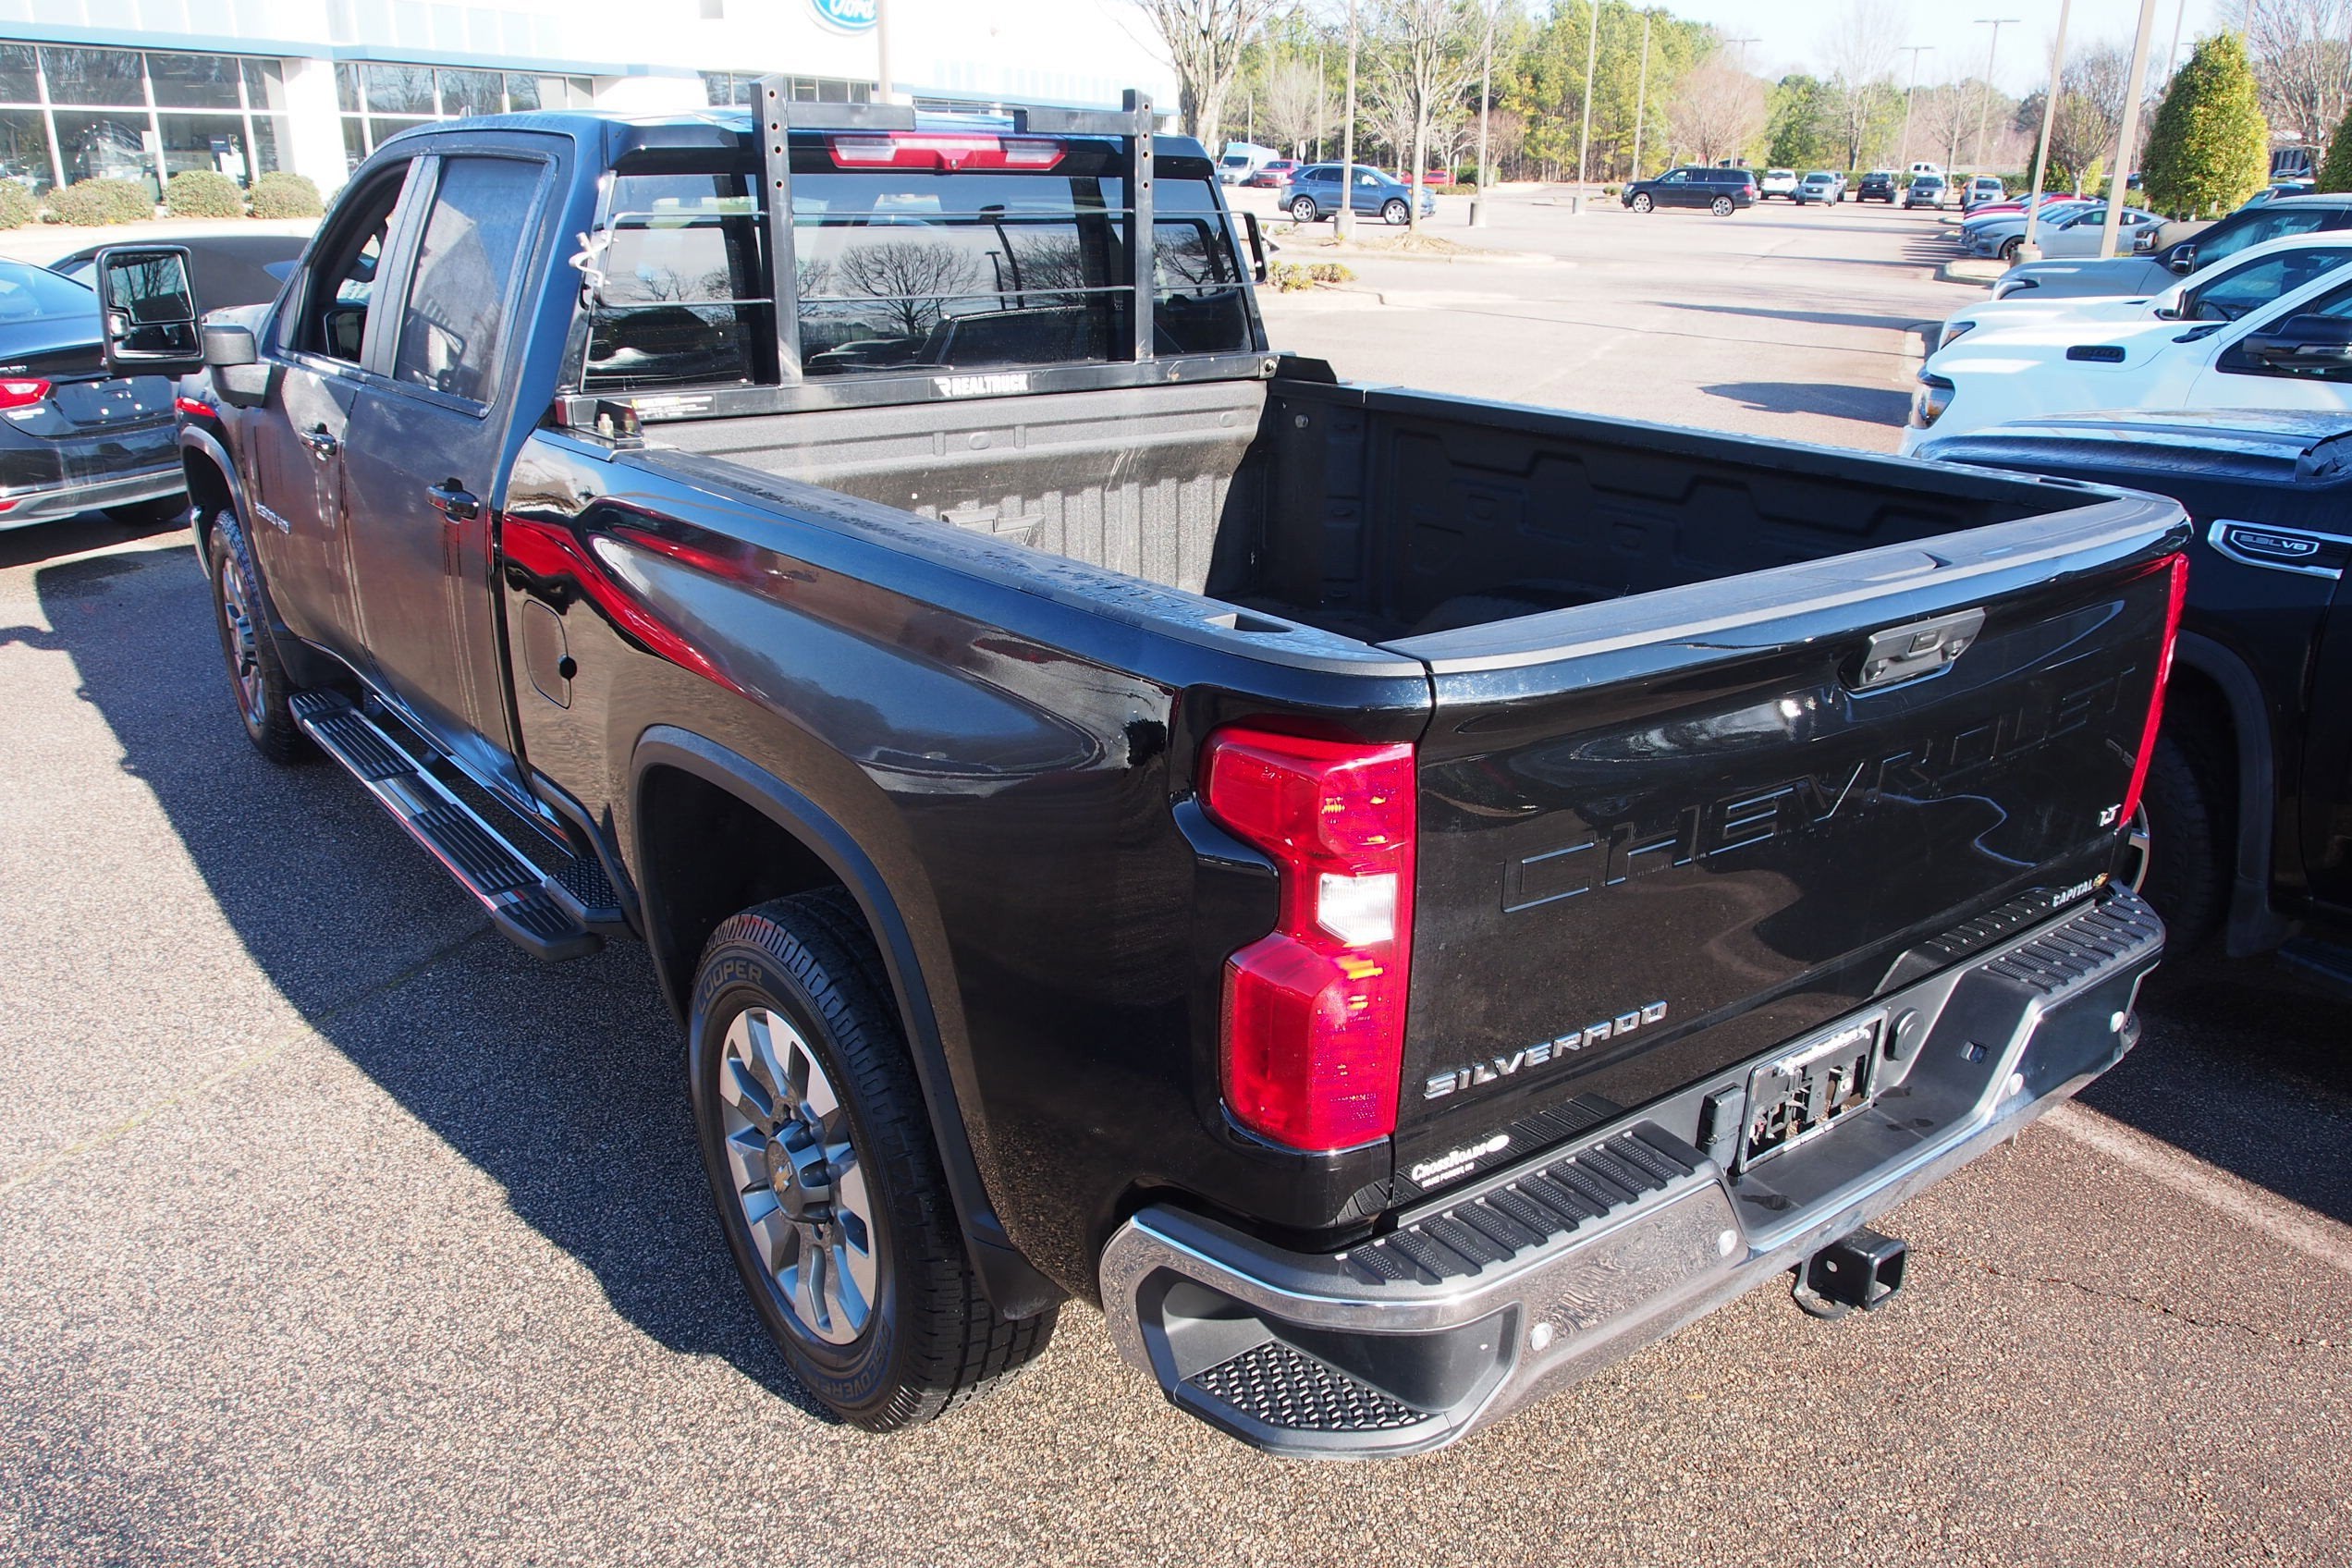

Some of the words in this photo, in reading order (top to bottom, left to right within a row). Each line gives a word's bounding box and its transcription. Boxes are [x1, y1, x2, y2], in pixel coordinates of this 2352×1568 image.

[950, 374, 1028, 396] REALTRUCK
[1501, 668, 2138, 913] CHEVROLET
[2099, 803, 2122, 827] LT
[2052, 878, 2093, 907] CAPITAL
[697, 960, 763, 1015] COOPER
[1424, 999, 1667, 1099] SILVERADO
[809, 1316, 892, 1400] DISCOVERE
